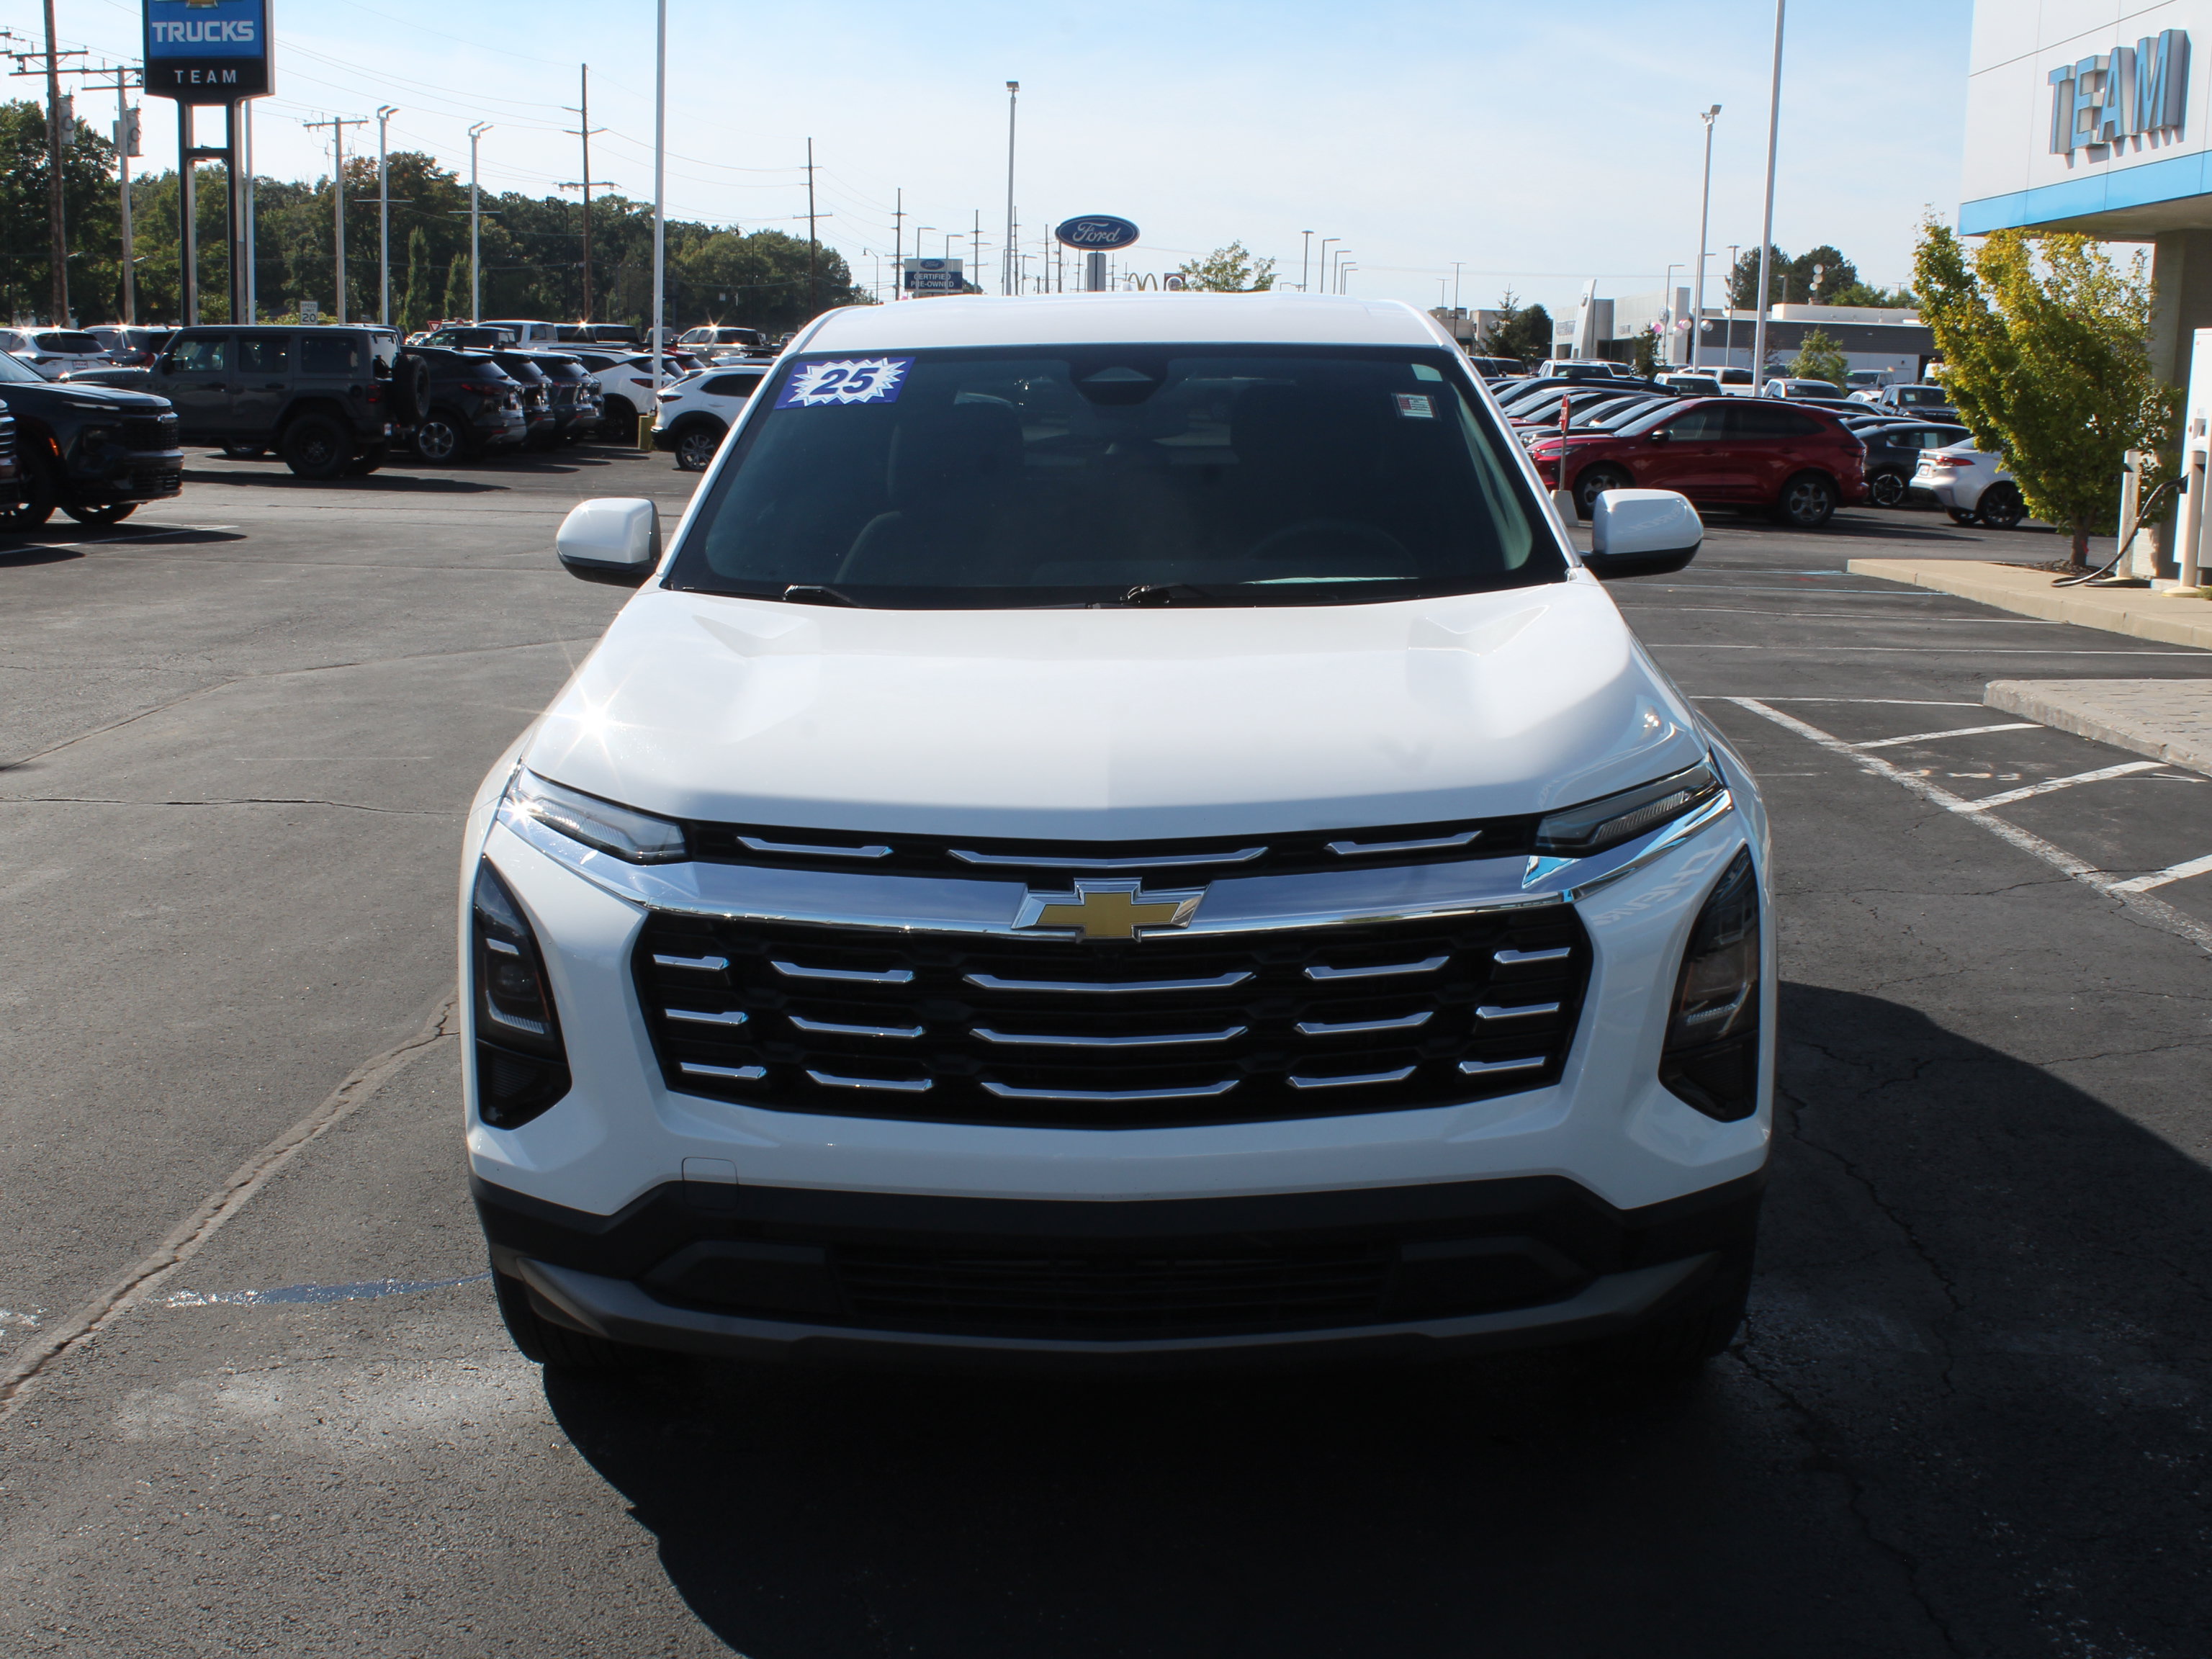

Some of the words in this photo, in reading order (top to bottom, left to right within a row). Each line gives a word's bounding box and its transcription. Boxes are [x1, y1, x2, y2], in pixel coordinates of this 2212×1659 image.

[152, 21, 254, 42] TRUCKS
[174, 70, 236, 84] TEAM
[2047, 29, 2191, 155] TEAM
[1072, 222, 1121, 243] Ford
[302, 313, 316, 322] 20
[809, 367, 881, 396] 25
